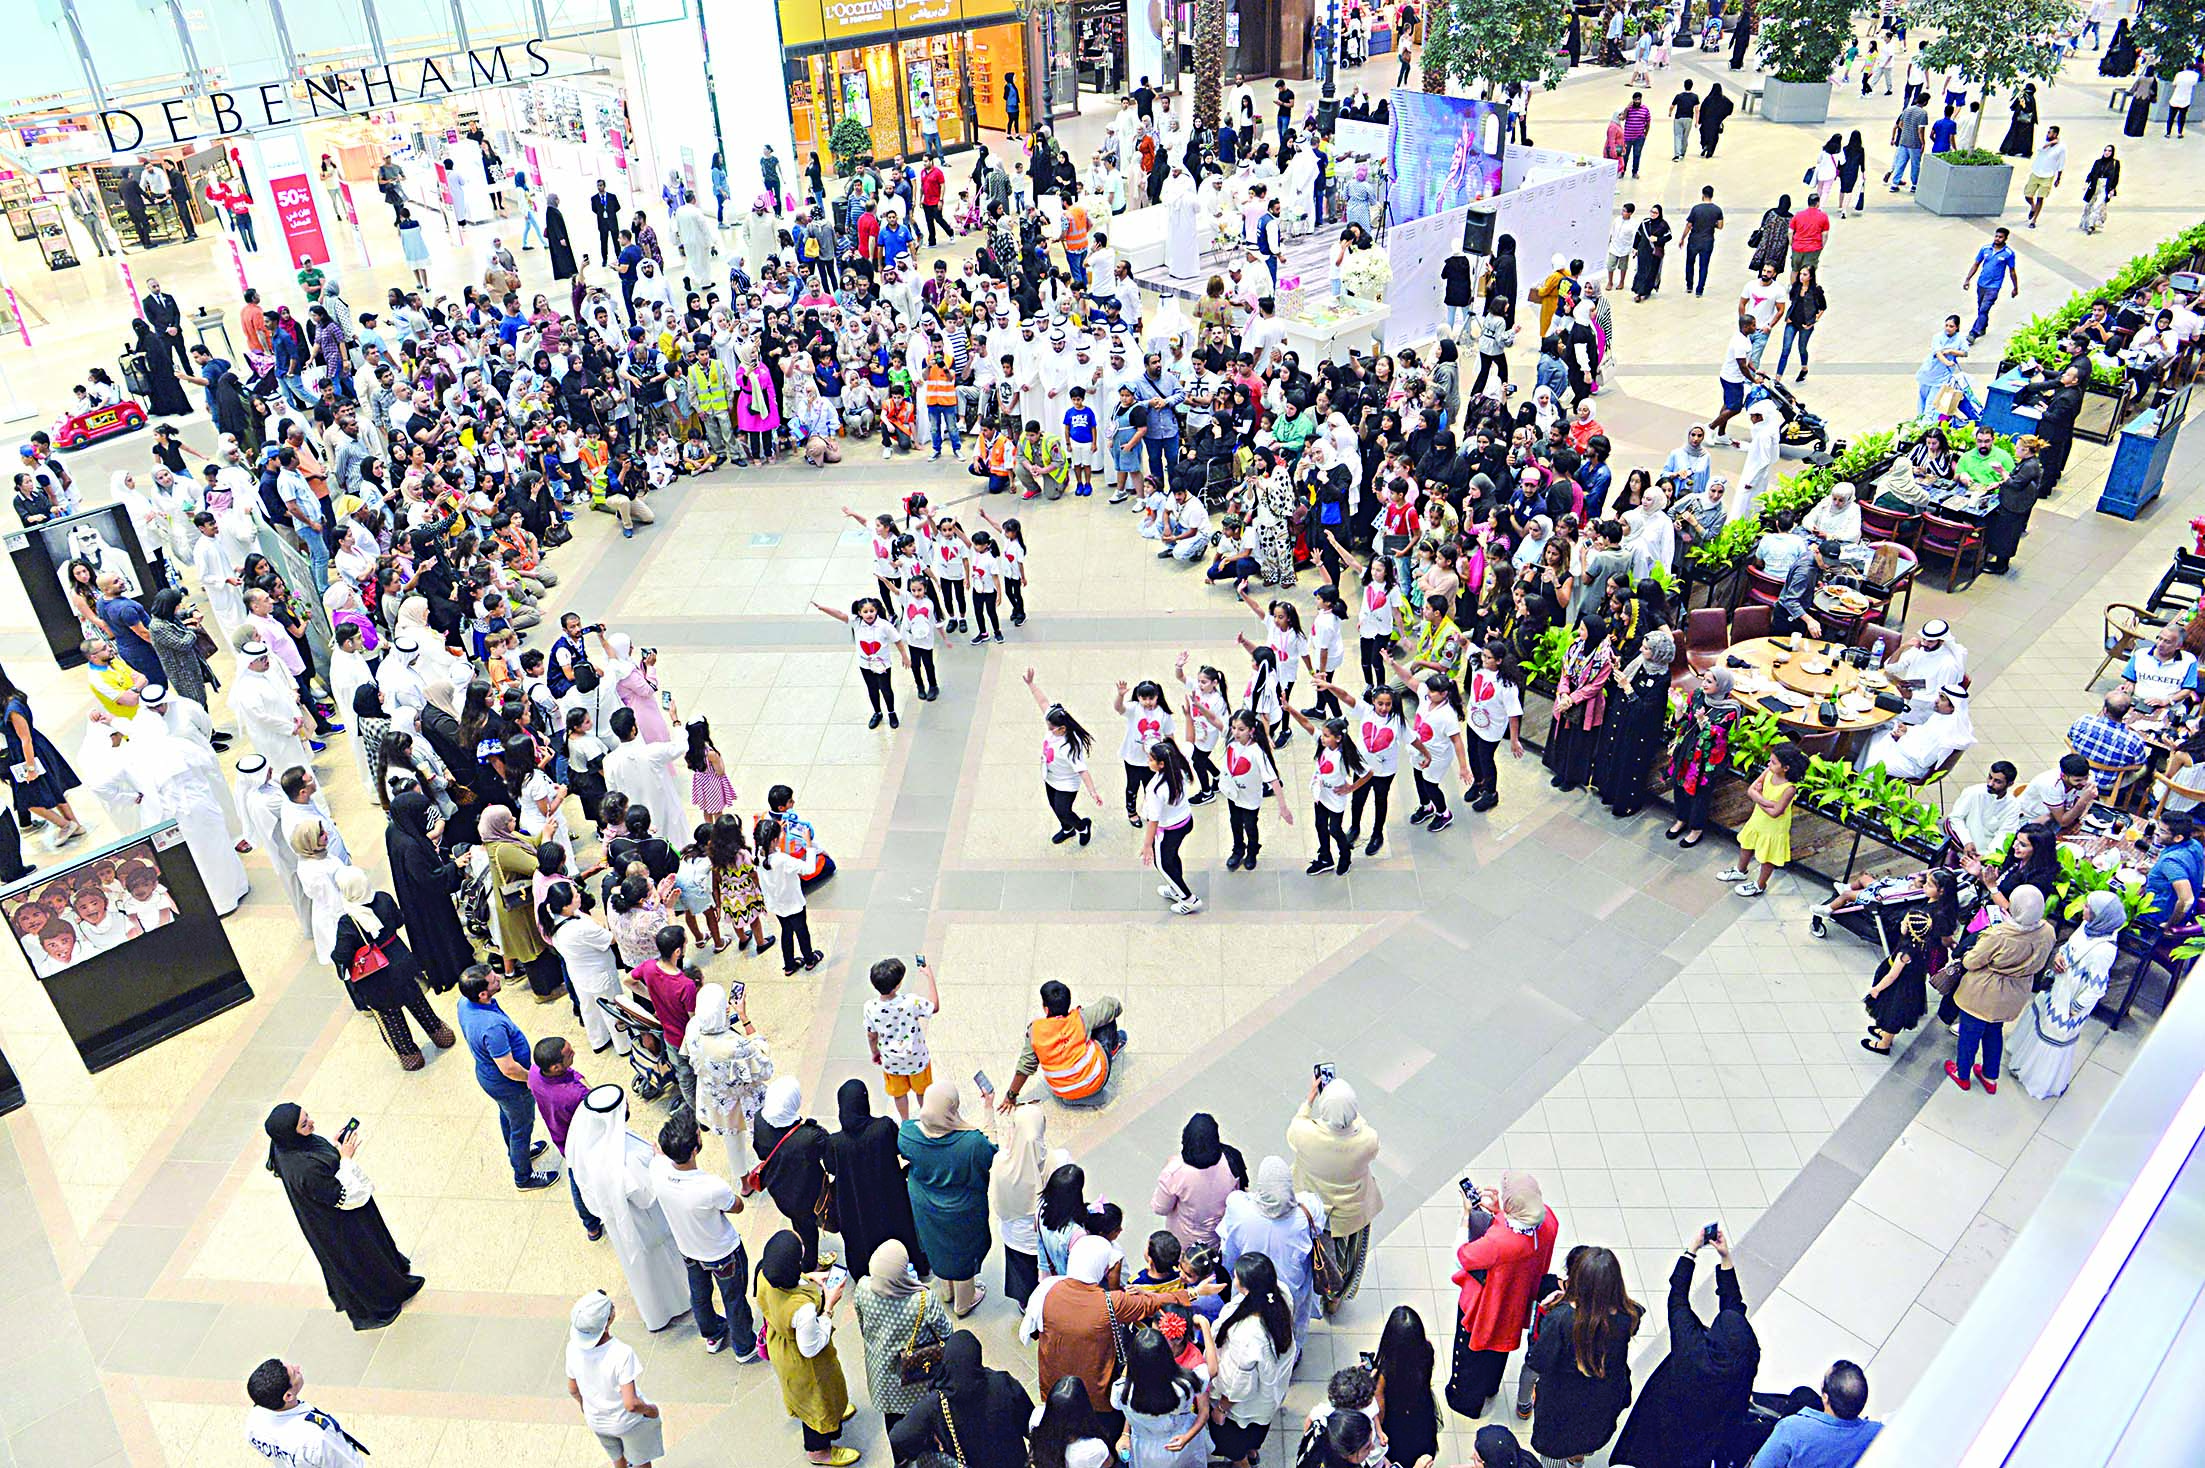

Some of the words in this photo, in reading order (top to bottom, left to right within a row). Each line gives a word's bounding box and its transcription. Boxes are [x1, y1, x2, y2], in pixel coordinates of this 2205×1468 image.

[98, 38, 551, 154] DEBENHAMS
[277, 188, 310, 207] 50%
[2138, 671, 2181, 686] HACKETT
[250, 1437, 297, 1468] SECURITY
